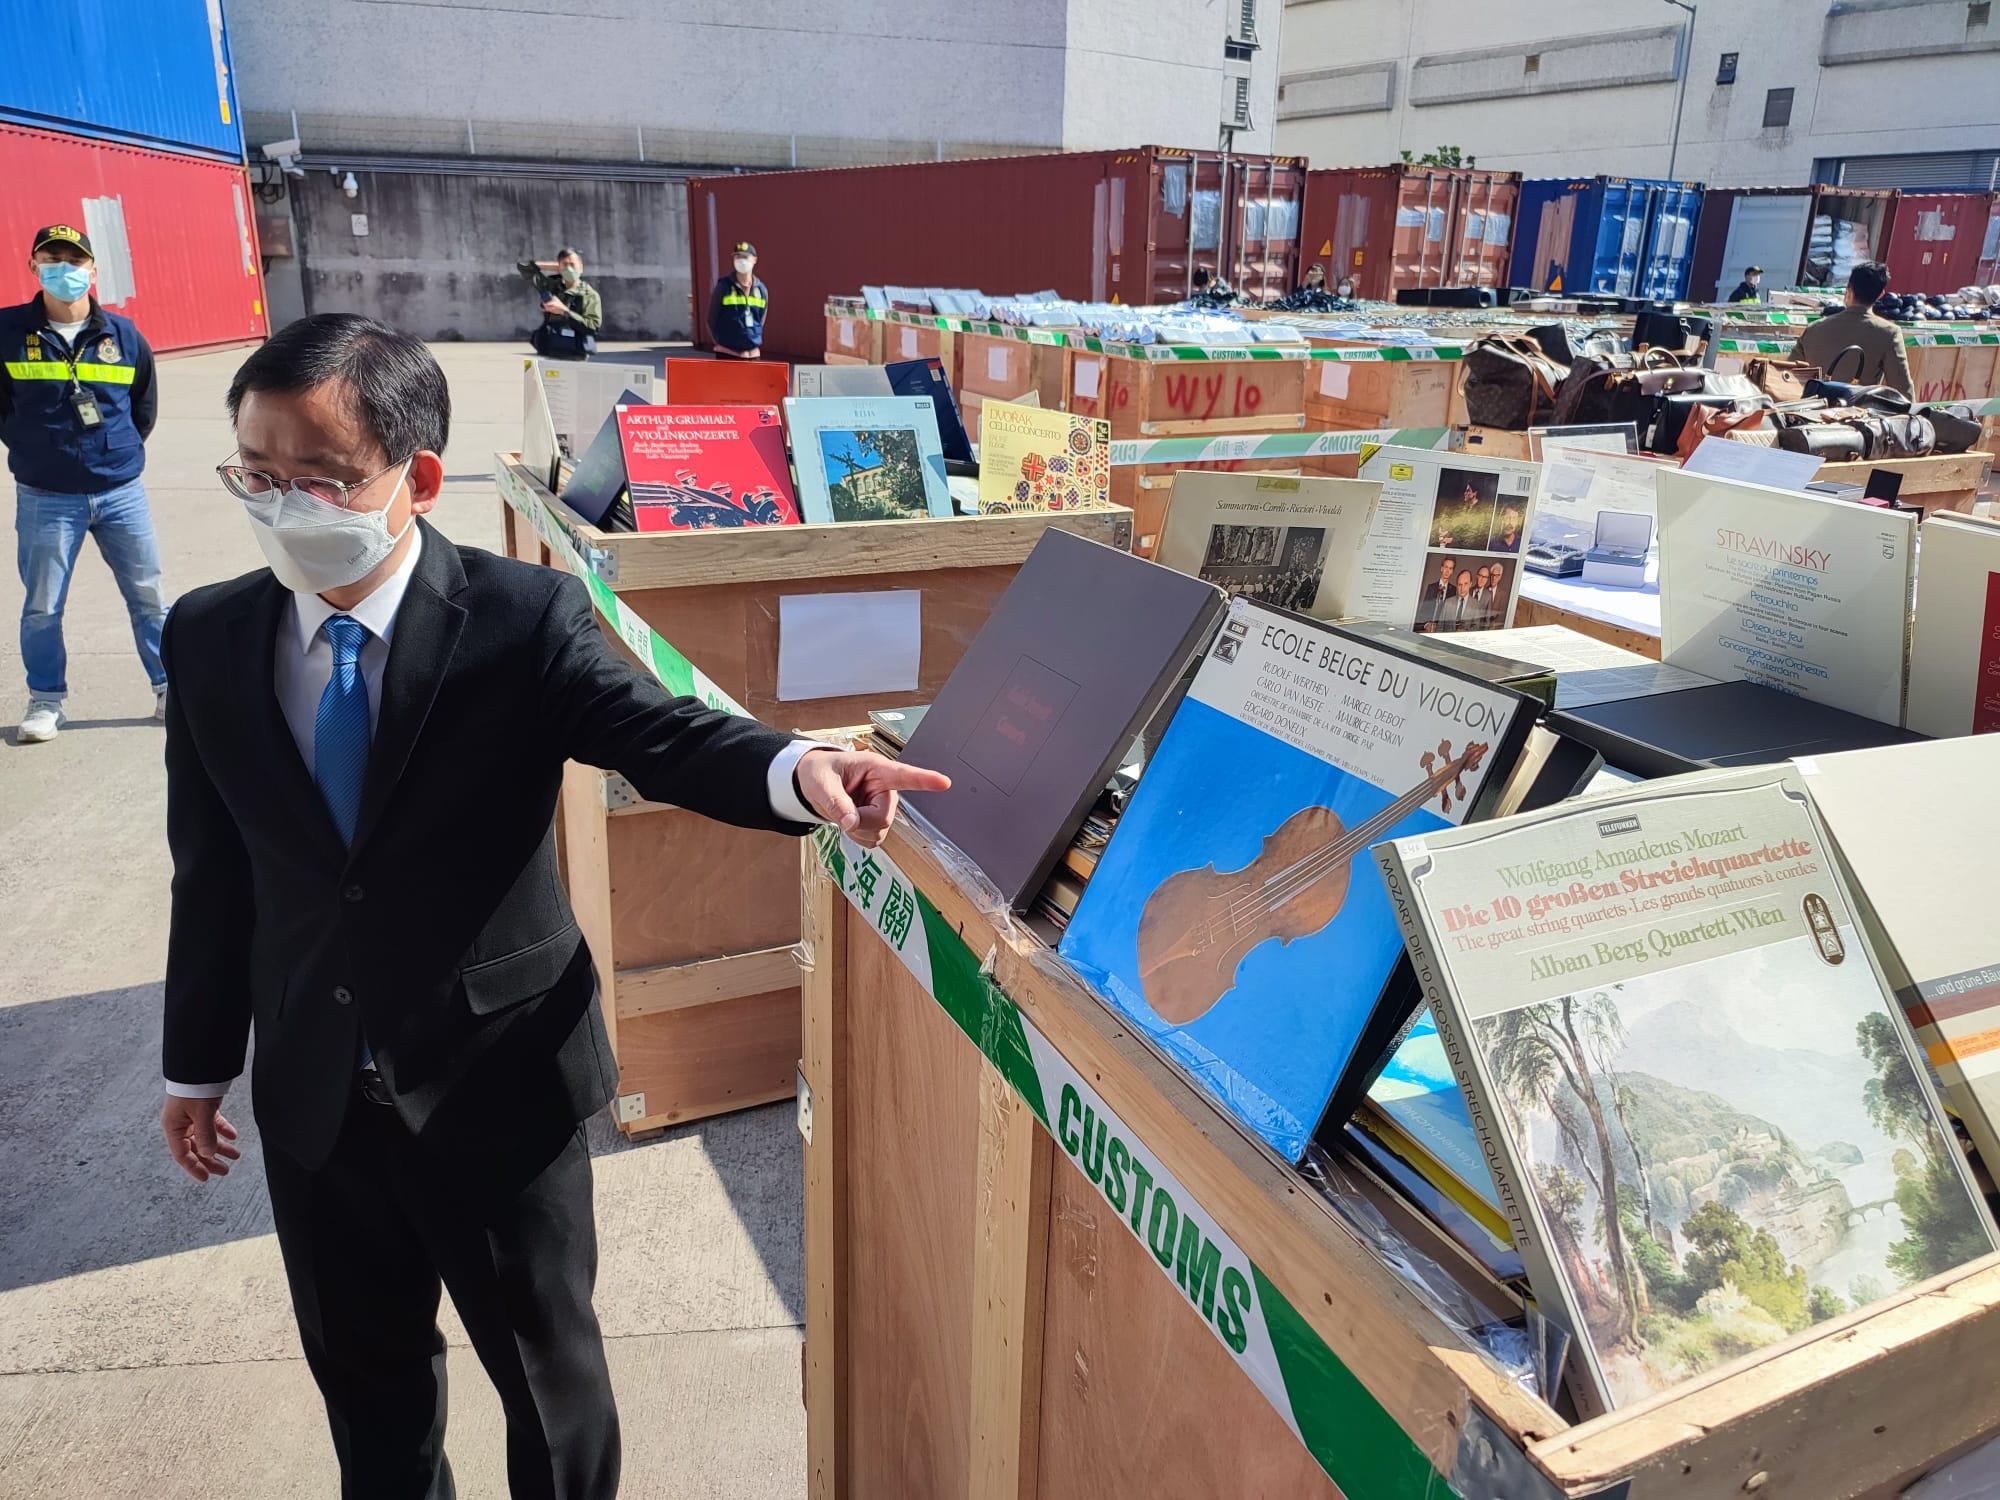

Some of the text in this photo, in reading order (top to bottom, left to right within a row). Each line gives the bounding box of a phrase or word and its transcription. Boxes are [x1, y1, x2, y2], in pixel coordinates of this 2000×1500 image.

[1211, 350, 1247, 360] CUSTOMS
[1343, 350, 1378, 360] CUSTOMS
[626, 415, 736, 425] ARTHUR GRUMIAUX
[629, 430, 740, 440] 7 VIOLINKONZERTE
[989, 421, 1062, 440] CELLO CONCERTO
[1216, 500, 1260, 512] Sammartini
[1262, 502, 1286, 513] Corelli
[1318, 505, 1343, 516] Vivaldi
[1716, 528, 1832, 570] STRAVINSKY
[1772, 568, 1819, 586] printemps
[1751, 590, 1799, 612] Petrouchka
[1718, 637, 1784, 666] Concertgebouw
[1746, 657, 1800, 680] Amsterdam
[1261, 625, 1506, 736] ECOLE BELGE DU VIOLON
[1262, 661, 1406, 729] RUDOLF WERTHEN MARCEL DEBOT
[1243, 700, 1309, 738] EDGARD DONEUX
[1250, 689, 1280, 710] ORCHESTRE
[1279, 702, 1288, 712] DE
[1287, 705, 1313, 724] CHAMBRE
[1313, 716, 1322, 727] DE
[1321, 720, 1330, 731] LA
[1330, 724, 1342, 736] RTB
[1361, 738, 1375, 752] PAR
[1256, 676, 1404, 748] CARLO VAN NESTE MAURICE RASKIN
[1600, 817, 1638, 834] TELEFUNKEN
[1496, 823, 1749, 889] Wolfgang Amadeus Mozart
[848, 848, 914, 952] 海關
[1440, 838, 1813, 932] Die 10 großen Streichquartette
[1452, 860, 1818, 952] The great string quartets Les grands quatuors à cordes
[1529, 906, 1786, 982] Alban Berg Quartett, Wien
[1954, 974, 1983, 994] grüne
[1408, 933, 1426, 963] DIE
[1418, 963, 1433, 983] 10
[1427, 985, 1464, 1066] GROSSEN
[1456, 1069, 1532, 1249] STREICHQUARTETTE
[1058, 1082, 1252, 1355] CUSTOMS
